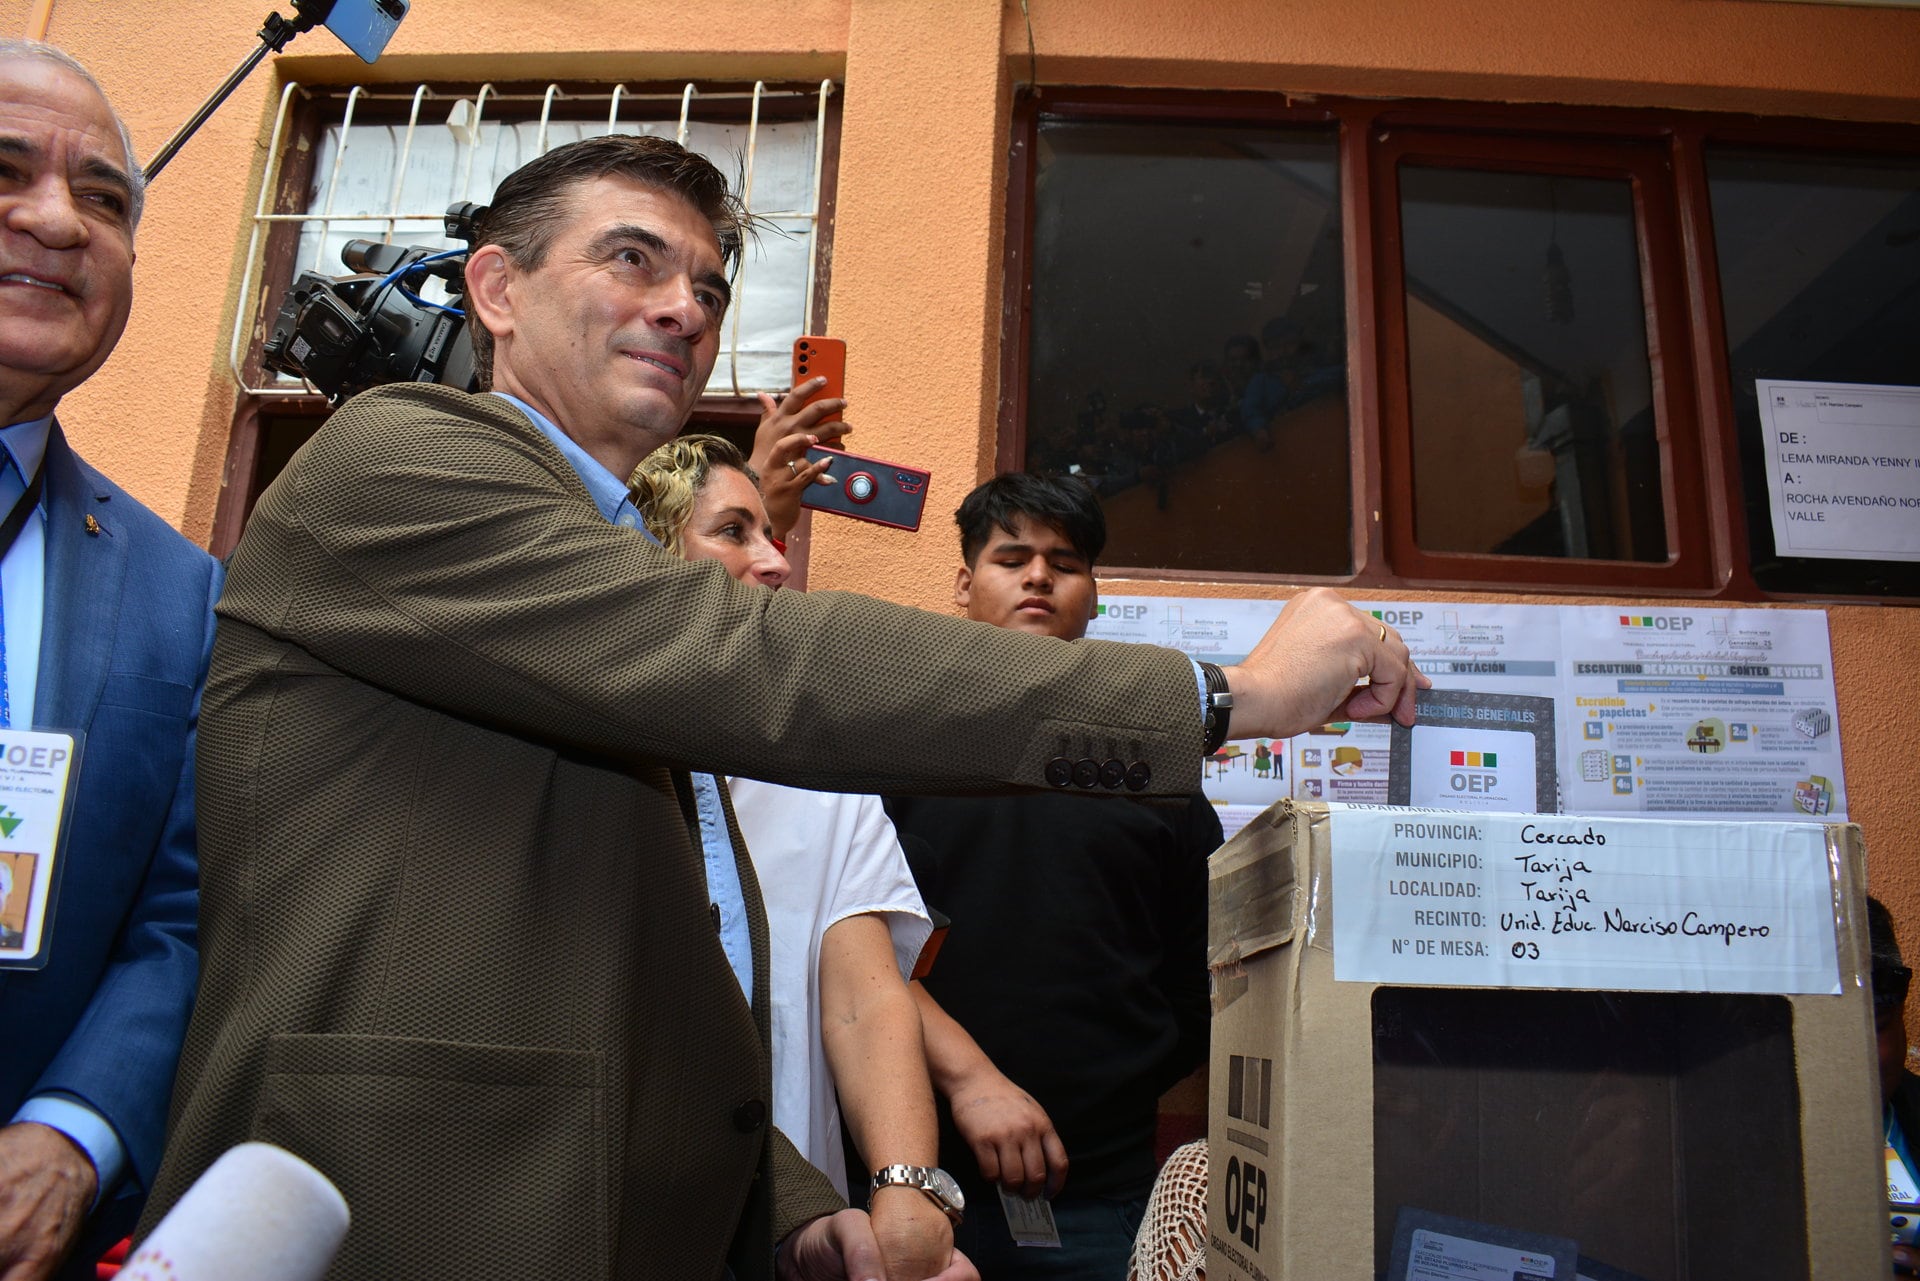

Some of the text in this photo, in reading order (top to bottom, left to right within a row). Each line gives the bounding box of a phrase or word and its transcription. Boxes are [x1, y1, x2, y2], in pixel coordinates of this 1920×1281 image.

[1779, 432, 1799, 444] DE
[1781, 453, 1813, 464] LEMA
[1816, 455, 1870, 466] MIRANDA
[1872, 457, 1912, 468] YENNY
[1784, 472, 1794, 484] A
[1786, 493, 1829, 505] ROCHA
[1832, 494, 1897, 507] AVENDAÑO
[1788, 511, 1825, 522] VALLE
[1108, 605, 1148, 619] OEP
[1384, 611, 1423, 625] OEP
[1655, 616, 1694, 630] OEP
[1452, 661, 1506, 673] VOTACIÓN
[1578, 664, 1643, 674] ESCRUTINIO
[1659, 664, 1720, 675] PAPELETAS
[1730, 666, 1769, 676] CONTEO
[1783, 666, 1819, 676] VOTOS
[1576, 697, 1626, 707] Escrutinio
[1414, 704, 1536, 723] ELECCIONES GENERALES
[1600, 708, 1647, 719] papeletas
[7, 745, 67, 768] OEP
[1305, 751, 1321, 763] 2do
[1306, 781, 1321, 792] 3ro
[1450, 773, 1498, 793] OEP
[1394, 823, 1482, 841] PROVINCIA:
[1520, 825, 1606, 846] Cercado
[1395, 851, 1482, 870] MUNICIPIO:
[1515, 854, 1592, 882] Tarija
[1389, 880, 1481, 898] LOCALIDAD:
[1520, 882, 1590, 911] Tarija
[1415, 909, 1486, 927] RECINTO:
[1605, 910, 1677, 936] Narciso
[1682, 913, 1770, 944] Campero
[1415, 939, 1436, 956] DE
[1442, 939, 1489, 957] MESA:
[1512, 942, 1540, 960] 03
[1225, 1155, 1267, 1253] OEP
